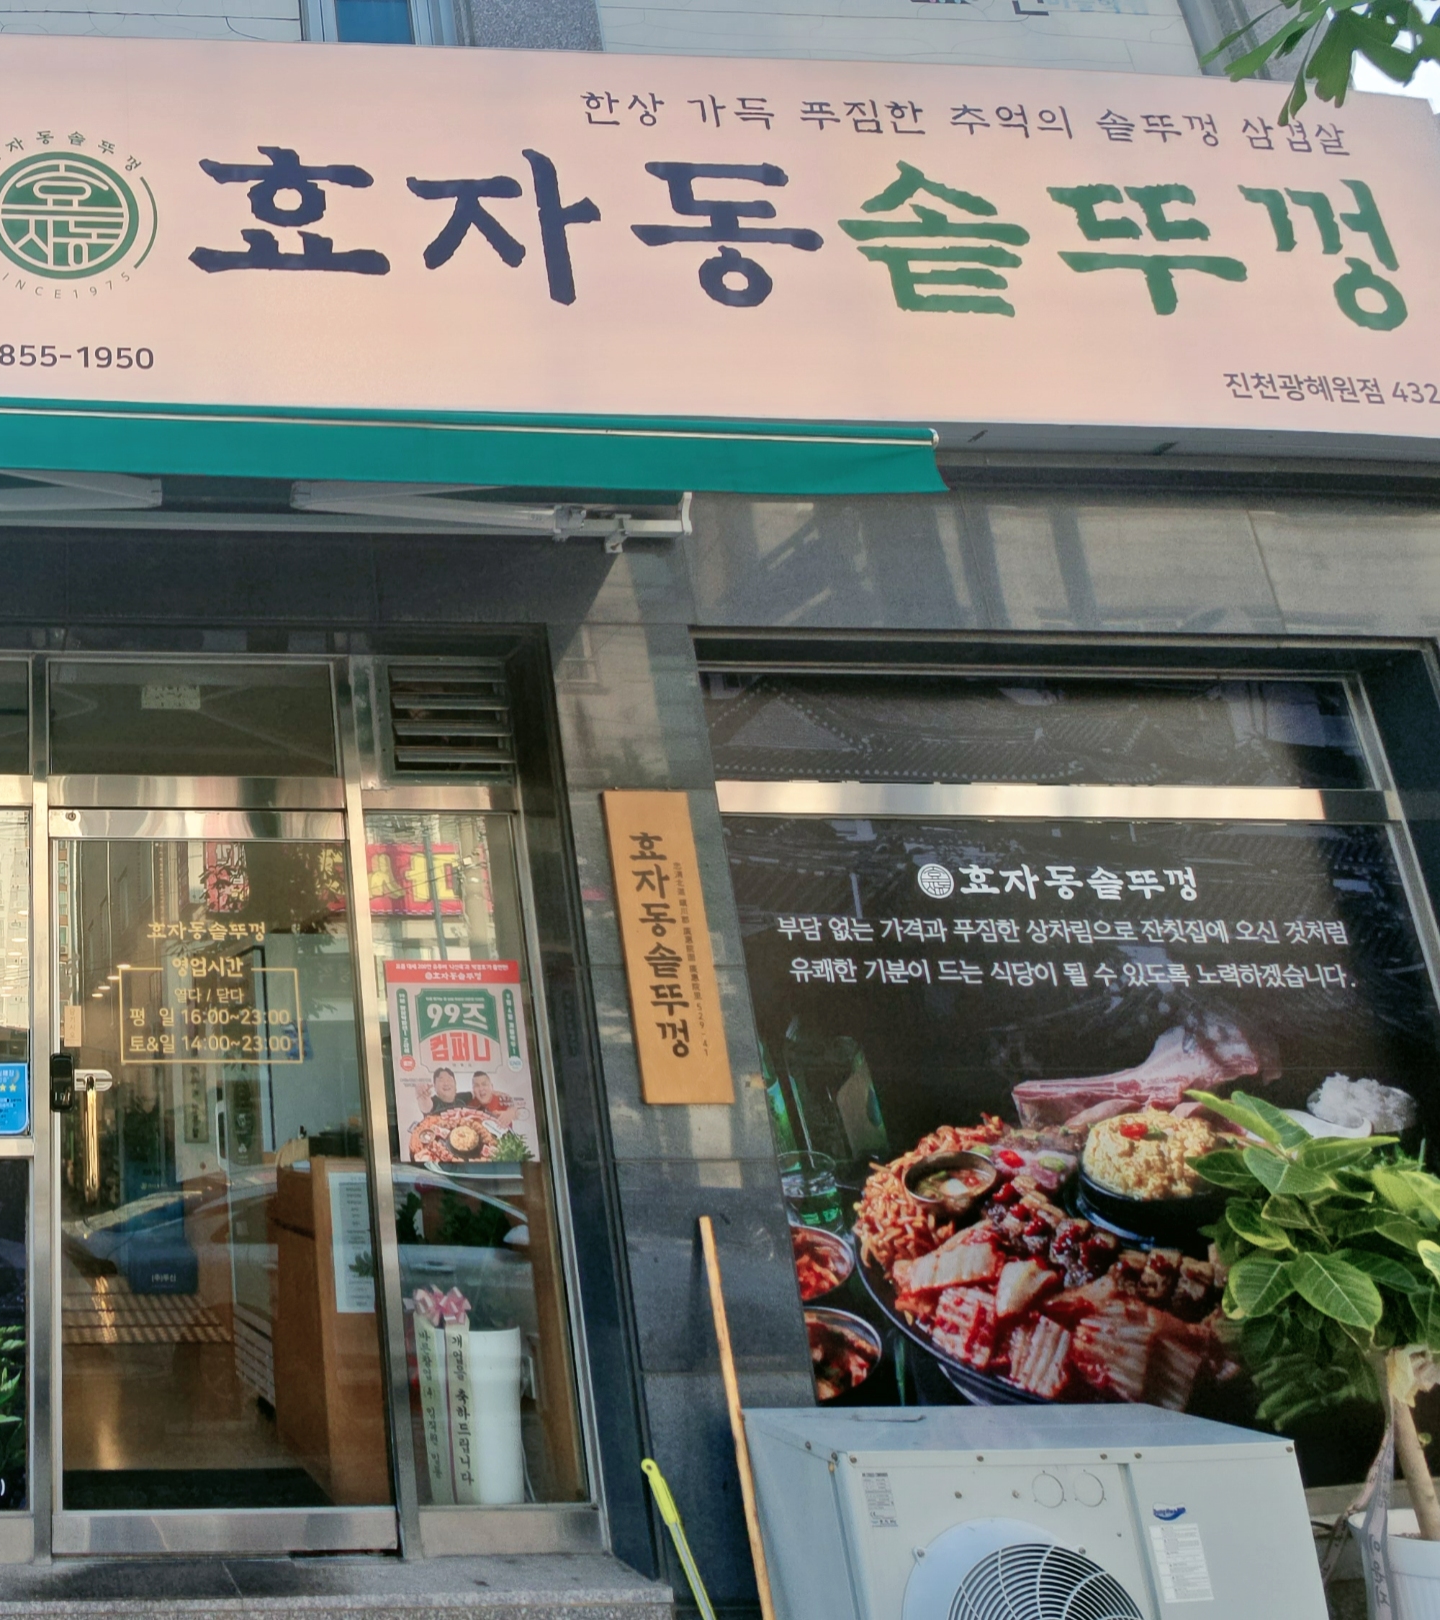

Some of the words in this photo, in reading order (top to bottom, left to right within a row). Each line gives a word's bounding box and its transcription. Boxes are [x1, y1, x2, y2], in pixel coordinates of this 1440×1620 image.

[581, 91, 666, 129] 한상
[686, 93, 776, 132] 가득
[799, 99, 926, 136] 푸짐한
[948, 103, 1074, 141] 추억의
[1095, 108, 1219, 149] 솥뚜껑
[1241, 116, 1351, 157] 삼겹살
[188, 144, 1409, 332] 효자동솥뚜껑
[1222, 372, 1386, 405] 진천광혜원점
[1391, 381, 1440, 405] 432
[959, 862, 1198, 904] 효자동솥뚜껑
[146, 920, 267, 943] 효자동솥뚜껑
[629, 831, 690, 1059] 효자동솥뚜껑
[776, 917, 822, 942] 부담
[827, 917, 874, 942] 없는
[880, 919, 947, 944] 가격과
[953, 919, 1021, 944] 푸짐한
[1025, 919, 1136, 945] 상차림으로
[1141, 919, 1229, 945] 잔칫집에
[1235, 921, 1281, 945] 오신
[1285, 920, 1349, 946] 것처럼
[171, 956, 244, 979] 영업시간
[788, 956, 858, 984] 유쾌한
[864, 957, 931, 985] 기분이
[937, 958, 983, 985] 드는
[989, 960, 1058, 987] 식당이
[1063, 960, 1089, 987] 될
[1093, 962, 1118, 986] 수
[1122, 961, 1190, 987] 있도록
[1196, 962, 1357, 990] 노력하겠습니다.
[173, 987, 202, 1004] 열다
[216, 987, 245, 1004] 닫다
[129, 1007, 146, 1026] 평
[158, 1007, 175, 1026] 일
[180, 1008, 291, 1026] 16:00~23:00
[426, 1002, 489, 1030] 99즈
[129, 1035, 176, 1054] 토&일
[180, 1035, 292, 1053] 14:00~23:00
[429, 1031, 491, 1062] 컴퍼니
[451, 1333, 465, 1382] 개업을
[454, 1388, 475, 1487] 축하드립니다
